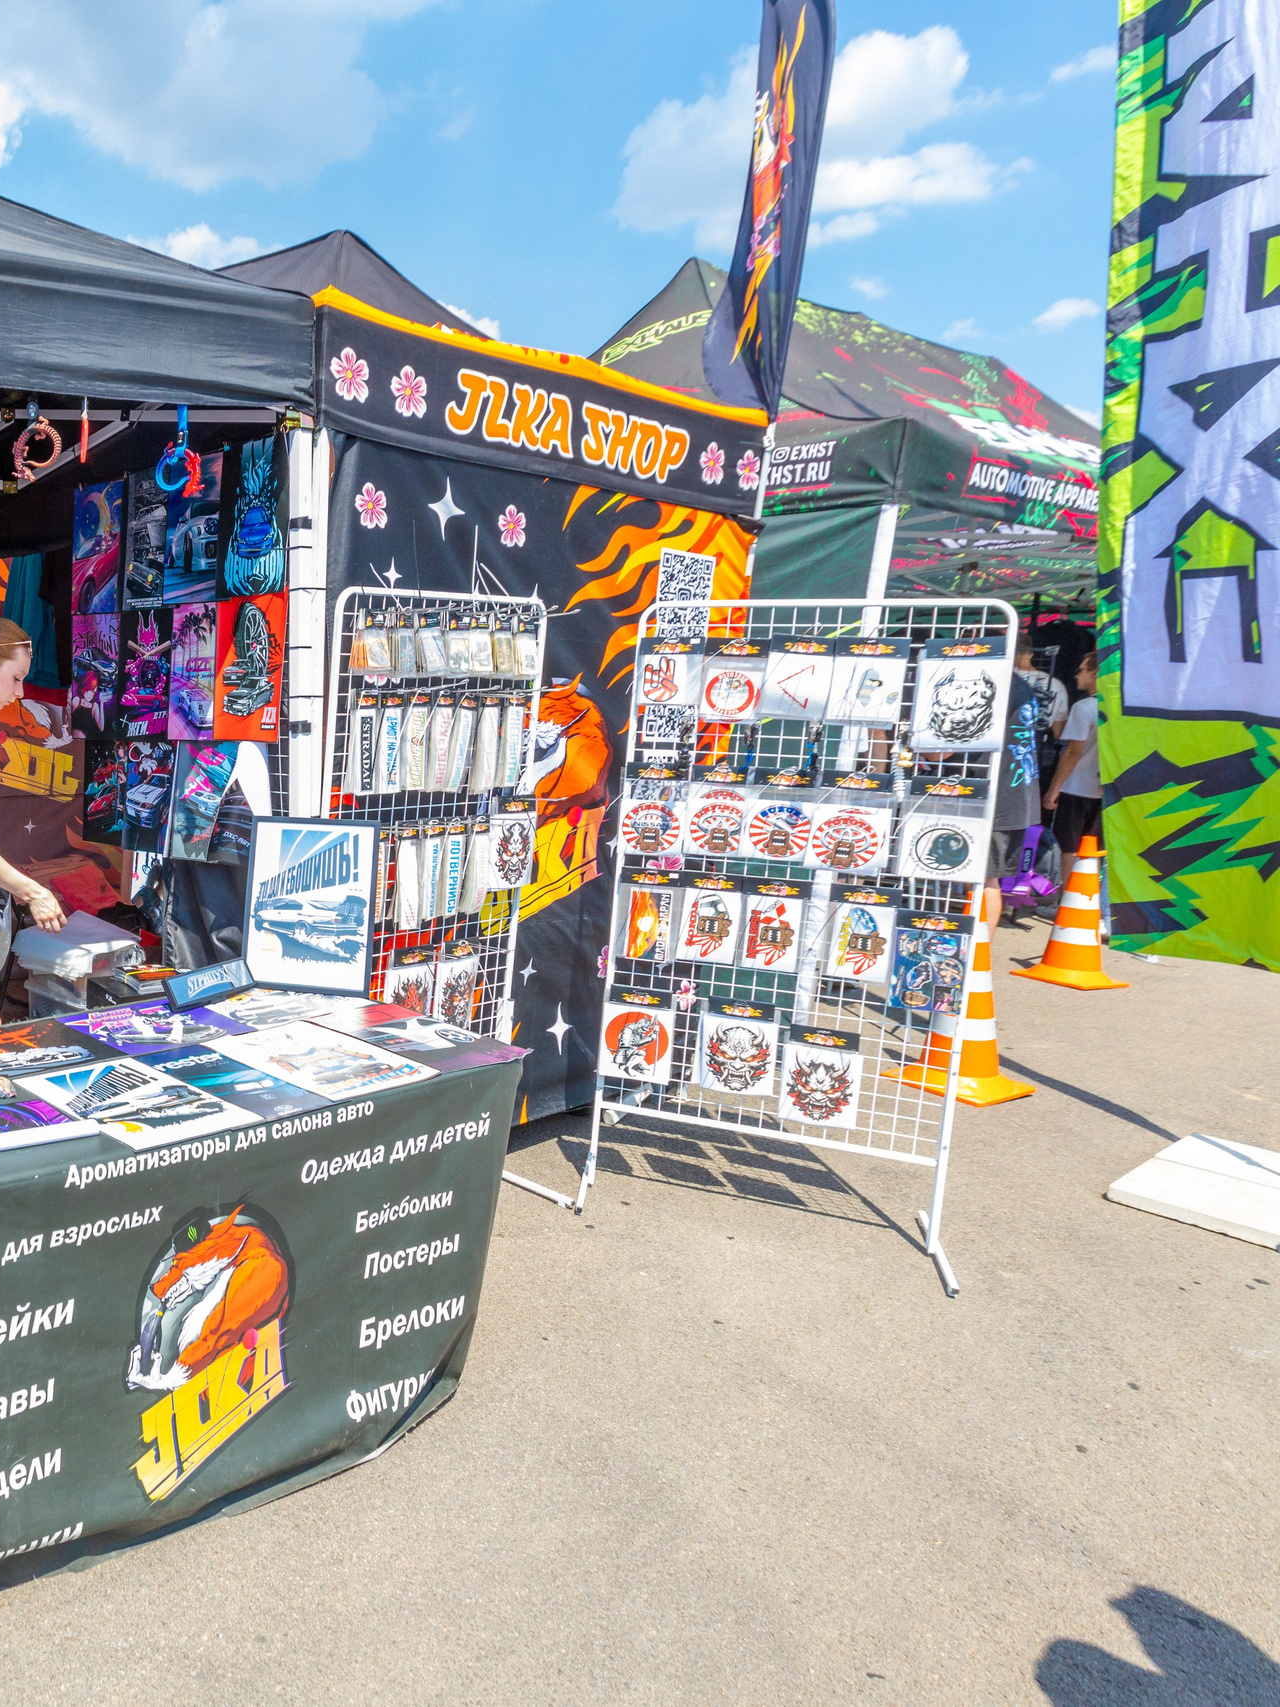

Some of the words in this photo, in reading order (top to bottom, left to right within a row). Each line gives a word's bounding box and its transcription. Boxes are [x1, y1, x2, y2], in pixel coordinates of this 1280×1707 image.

[445, 368, 573, 460] JLKA
[582, 400, 691, 484] SHOP
[790, 440, 838, 461] EXHST
[969, 462, 1056, 501] AUTOMOTIVE
[824, 818, 873, 833] TOYOTA
[941, 823, 962, 831] pedro
[961, 829, 976, 845] pedro
[285, 833, 360, 896] ЕБОШИШЬ!
[447, 840, 461, 914] #ОТВЕРНИСЬ
[659, 894, 671, 921] JAPAN
[684, 900, 700, 947] HONDA
[761, 899, 784, 915] MOTORS
[653, 936, 666, 961] MADE
[835, 916, 852, 967] SUBARU
[65, 1136, 231, 1190] Ароматизаторы
[235, 1127, 267, 1150] для
[272, 1112, 333, 1140] салона
[337, 1100, 374, 1126] авто
[301, 1141, 386, 1186] Одежда
[389, 1132, 427, 1162] для
[431, 1112, 492, 1151] детей
[1, 1231, 44, 1266] для
[50, 1204, 164, 1249] взрослых
[355, 1190, 454, 1233] Бейсболки
[363, 1233, 460, 1280] Постеры
[358, 1295, 466, 1350] Брелоки
[345, 1366, 436, 1424] Фигурк
